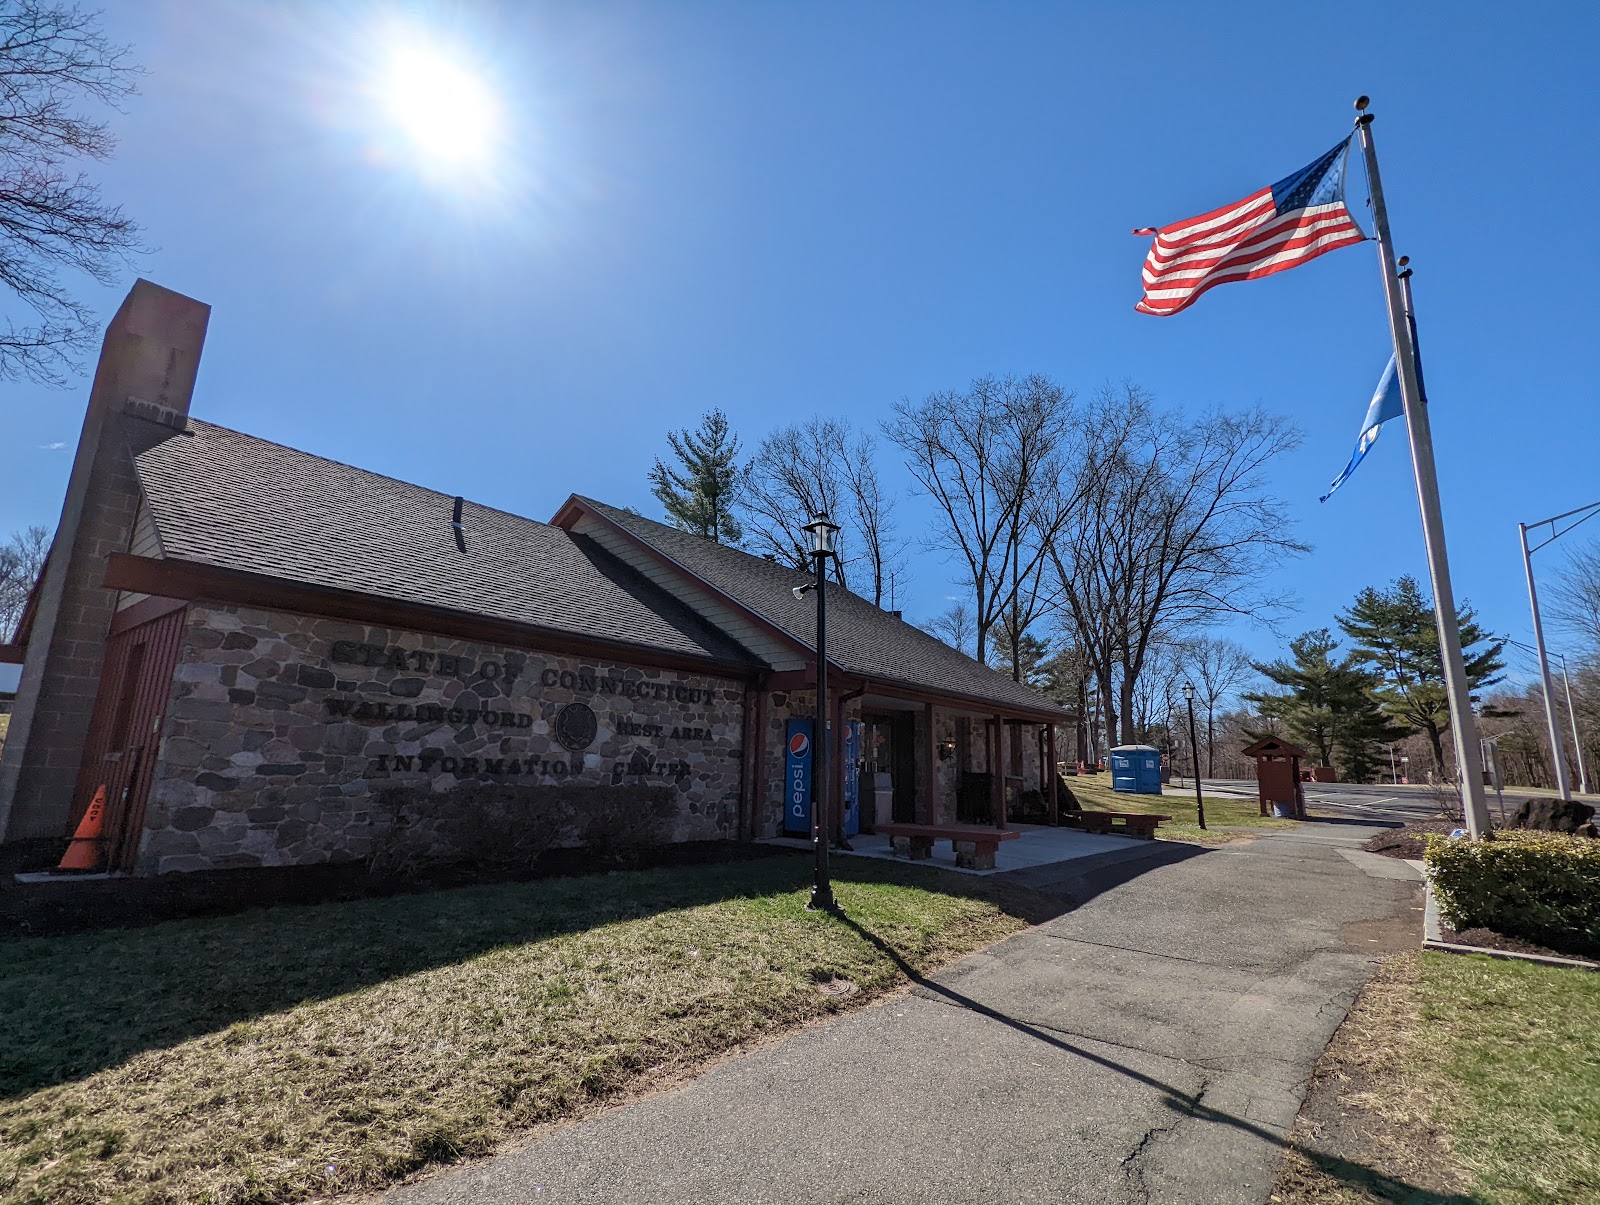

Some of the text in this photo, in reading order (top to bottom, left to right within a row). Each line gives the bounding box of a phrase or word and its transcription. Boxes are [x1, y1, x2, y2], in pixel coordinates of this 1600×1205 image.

[333, 641, 716, 706] STATE OF CONNECTICUT
[325, 698, 714, 741] WALLINGFORD REST AREA
[375, 754, 692, 777] INFORMATION CENTER
[792, 762, 806, 818] pepsi
